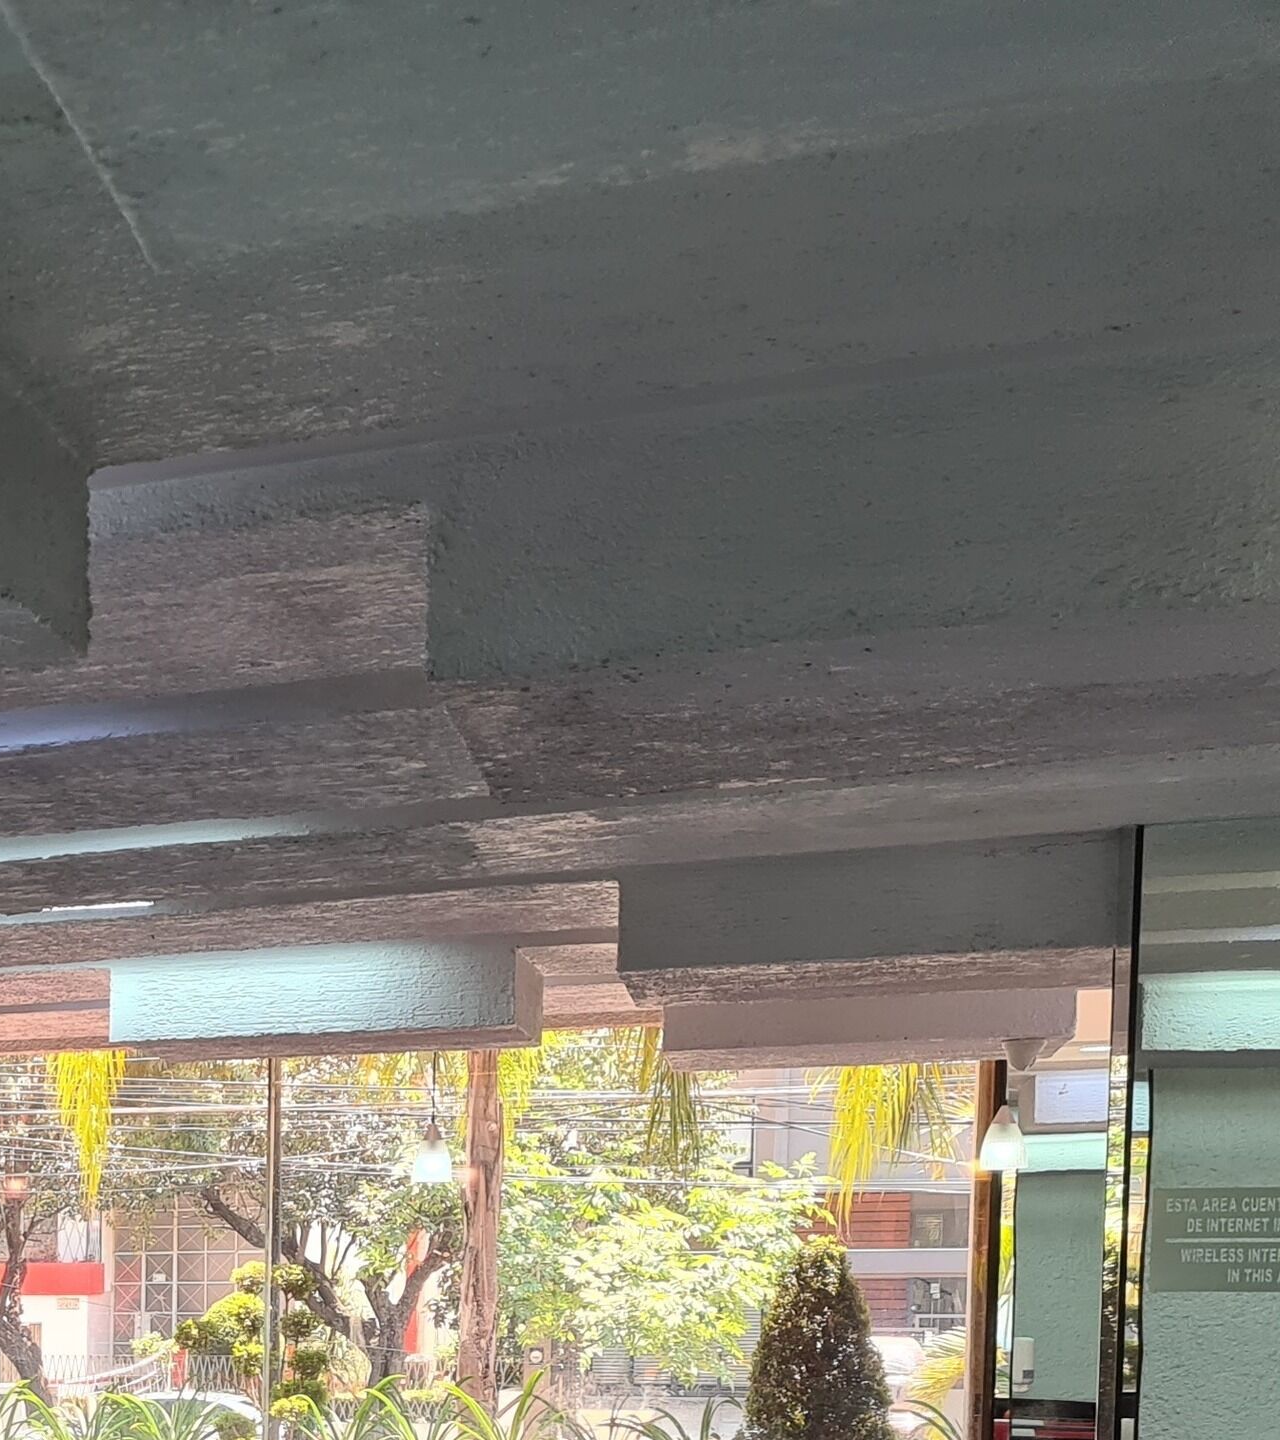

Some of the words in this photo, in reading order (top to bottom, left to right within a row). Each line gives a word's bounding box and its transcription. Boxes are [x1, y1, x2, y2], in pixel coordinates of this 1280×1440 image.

[1166, 1198, 1197, 1212] ESTA
[1202, 1197, 1237, 1212] AREA
[1187, 1219, 1202, 1232] DE
[1207, 1218, 1269, 1232] INTERNET
[1181, 1248, 1243, 1263] WIRELESS
[1228, 1269, 1240, 1283] IN
[1244, 1269, 1272, 1283] THIS
